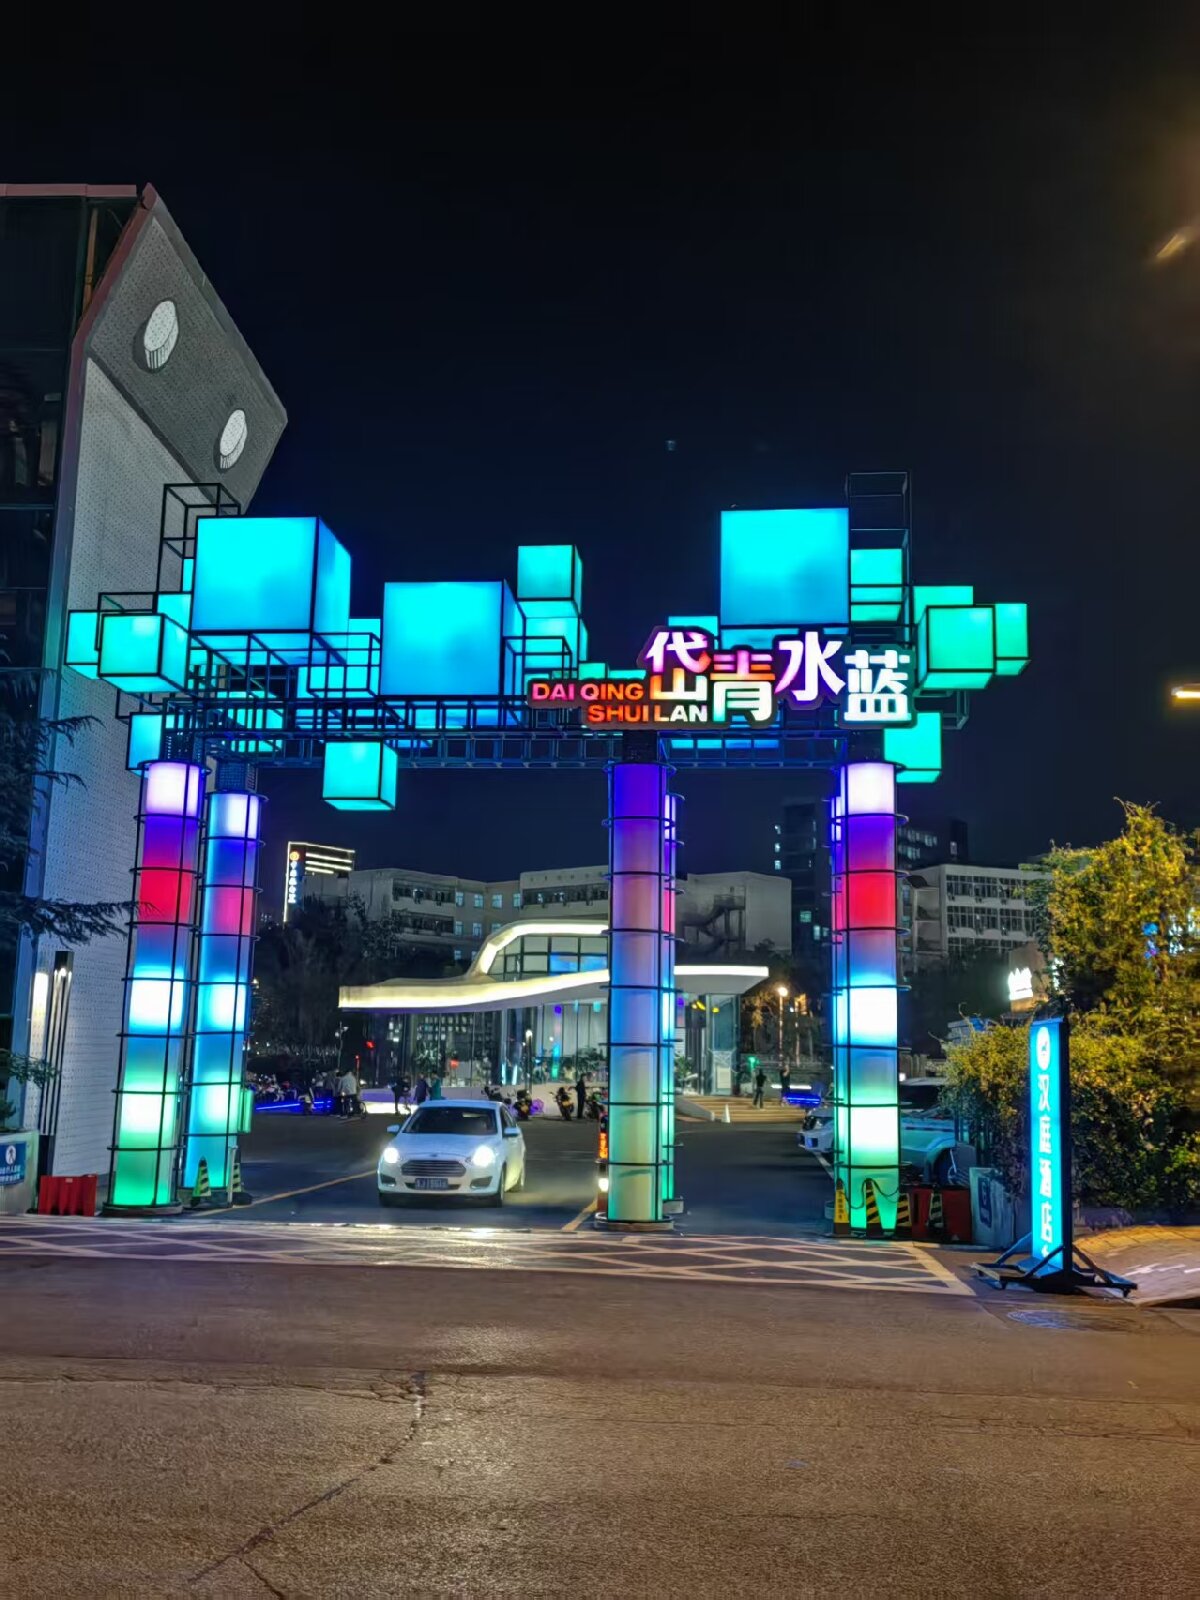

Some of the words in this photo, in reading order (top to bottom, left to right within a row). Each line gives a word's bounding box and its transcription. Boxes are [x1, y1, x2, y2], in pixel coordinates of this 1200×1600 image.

[645, 630, 912, 723] 岱青水蓝
[532, 683, 575, 701] DAI
[580, 683, 644, 701] QING
[587, 704, 650, 723] SHUI
[653, 704, 708, 723] LAN
